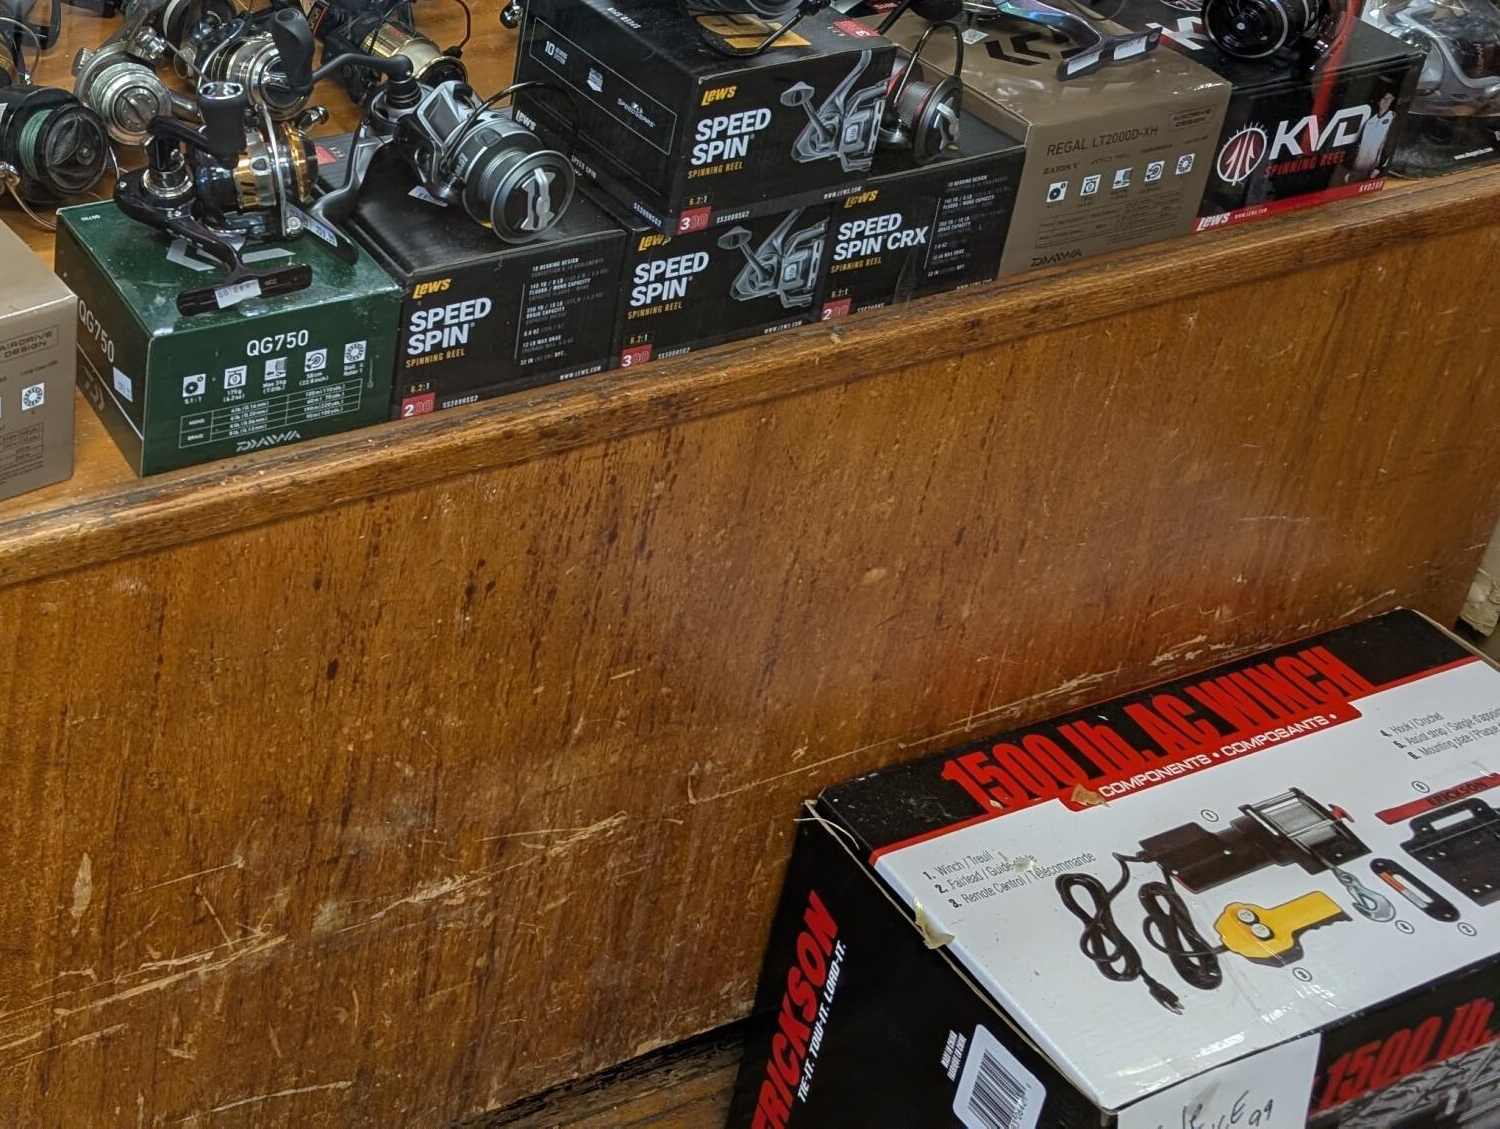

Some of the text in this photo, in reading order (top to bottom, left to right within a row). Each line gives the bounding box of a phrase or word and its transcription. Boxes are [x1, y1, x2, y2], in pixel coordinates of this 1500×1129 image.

[695, 108, 772, 142] SPEED
[1269, 103, 1372, 160] KVD
[1046, 138, 1088, 157] REGAL
[687, 161, 747, 180] SPINNING REEL
[1265, 155, 1317, 179] SPINNING
[837, 213, 903, 241] SPEED
[887, 226, 929, 251] CRX
[633, 252, 709, 285] SPEED
[830, 255, 882, 274] SPINNING REEL
[410, 297, 493, 333] SPEED
[627, 300, 683, 320] SPINNING REEL
[78, 298, 114, 365] QG750
[246, 329, 310, 357] QG750
[3, 340, 48, 359] DESIGN
[405, 348, 467, 369] SPINNING REEL
[940, 646, 1376, 816] 1500 lb. AC WINCH
[1098, 713, 1330, 799] COMPONENTS COMPOSANTS
[1426, 780, 1488, 807] ERICKSON
[934, 859, 963, 878] Winch
[968, 849, 996, 866] Treuil
[961, 885, 999, 904] Remote
[998, 875, 1026, 894] Control
